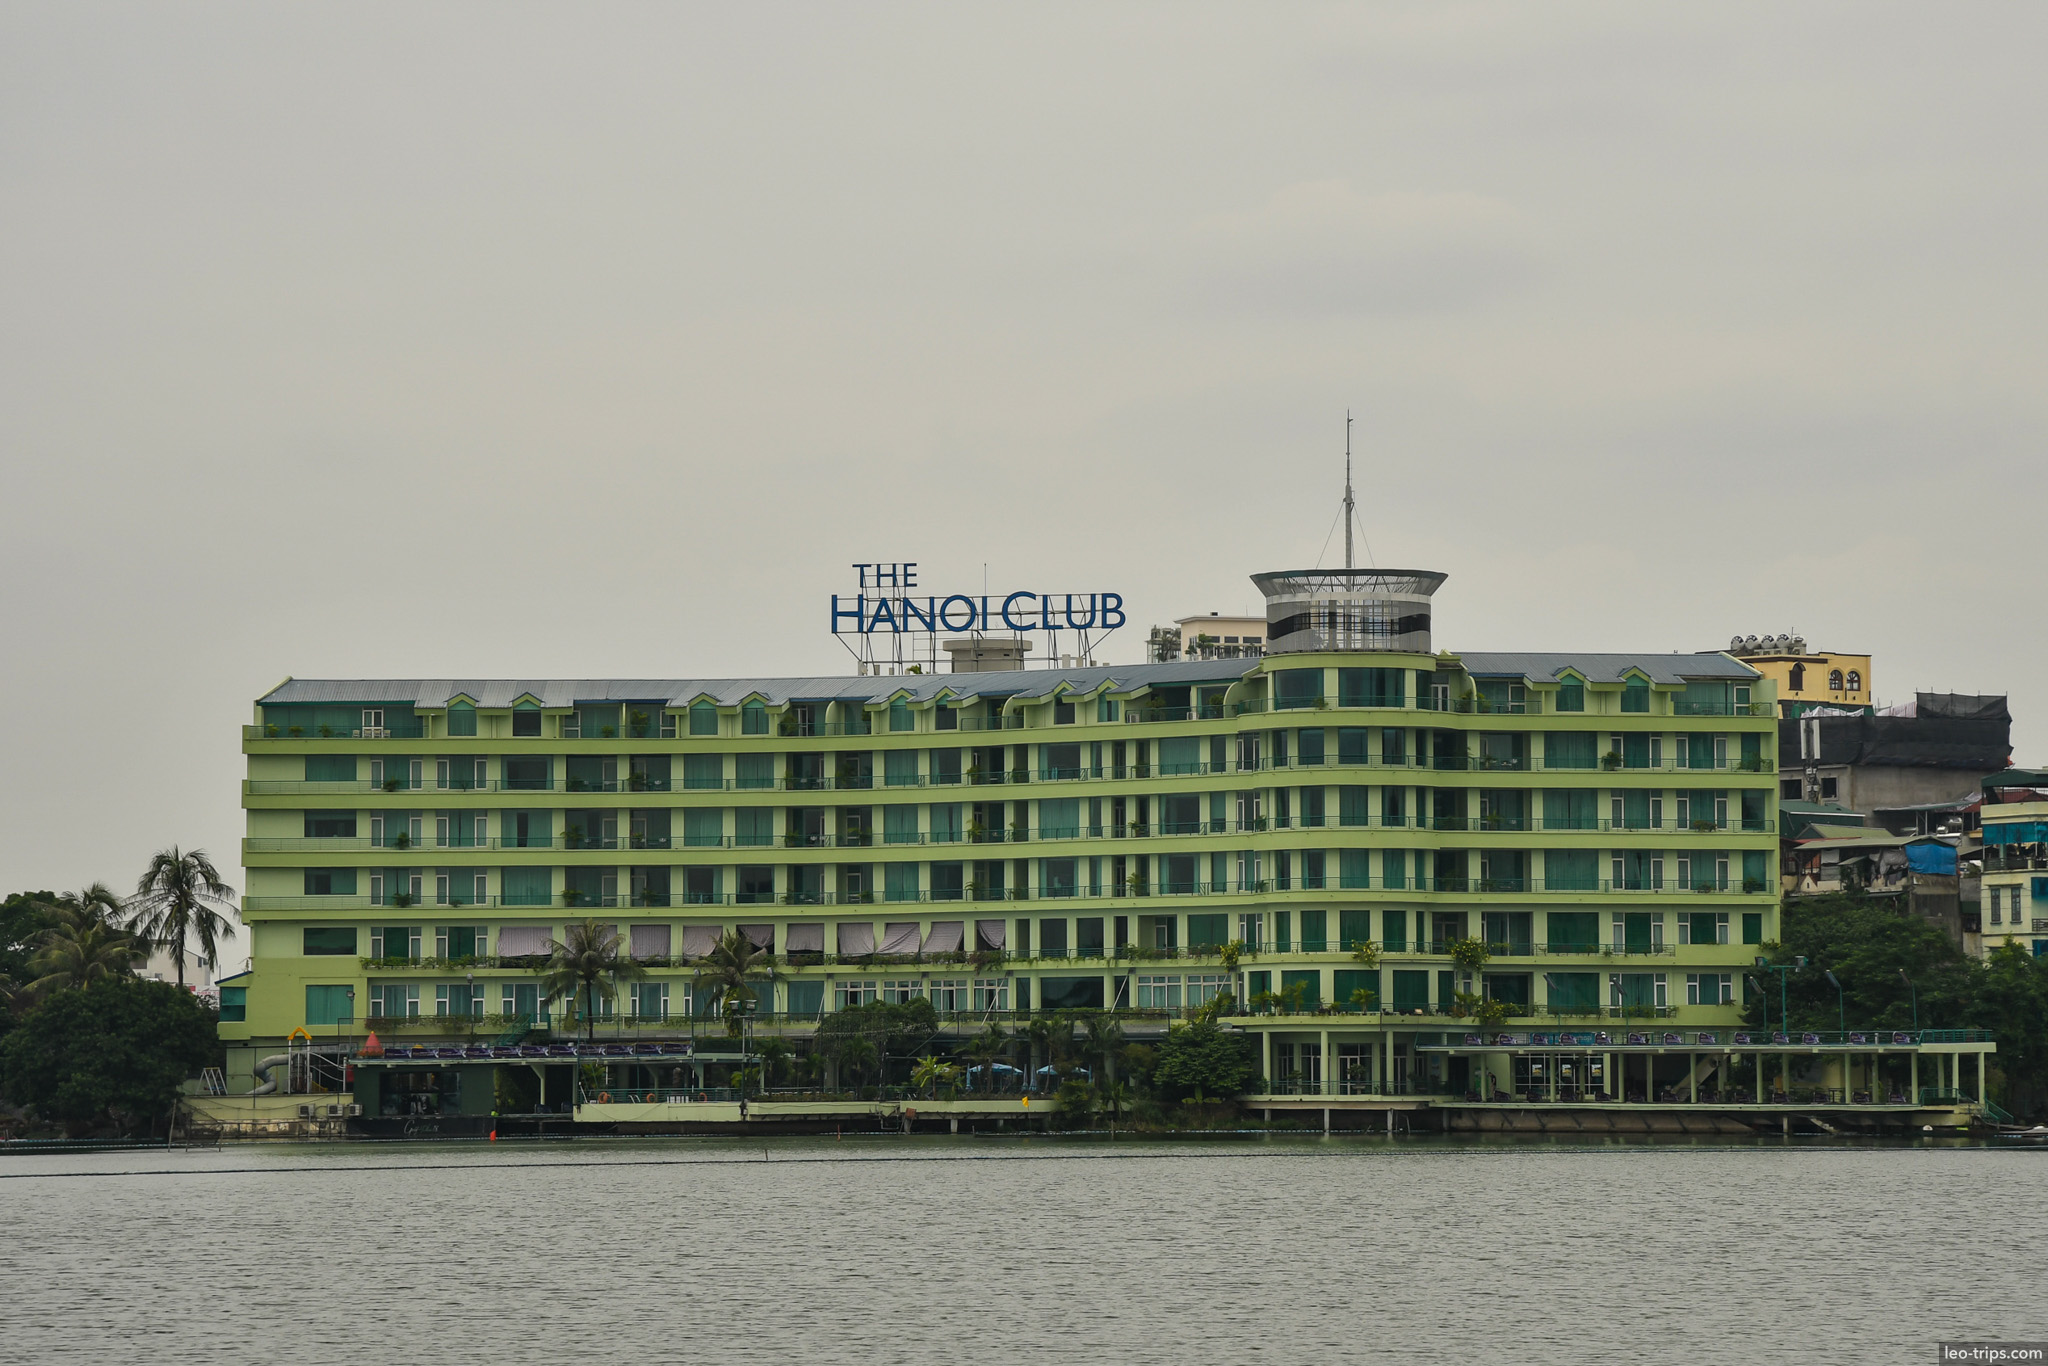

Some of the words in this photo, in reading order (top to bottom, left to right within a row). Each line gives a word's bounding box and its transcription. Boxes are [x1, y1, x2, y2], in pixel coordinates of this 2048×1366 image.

[852, 563, 917, 587] THE
[831, 594, 988, 633] HANOI
[1001, 591, 1126, 631] CLUB
